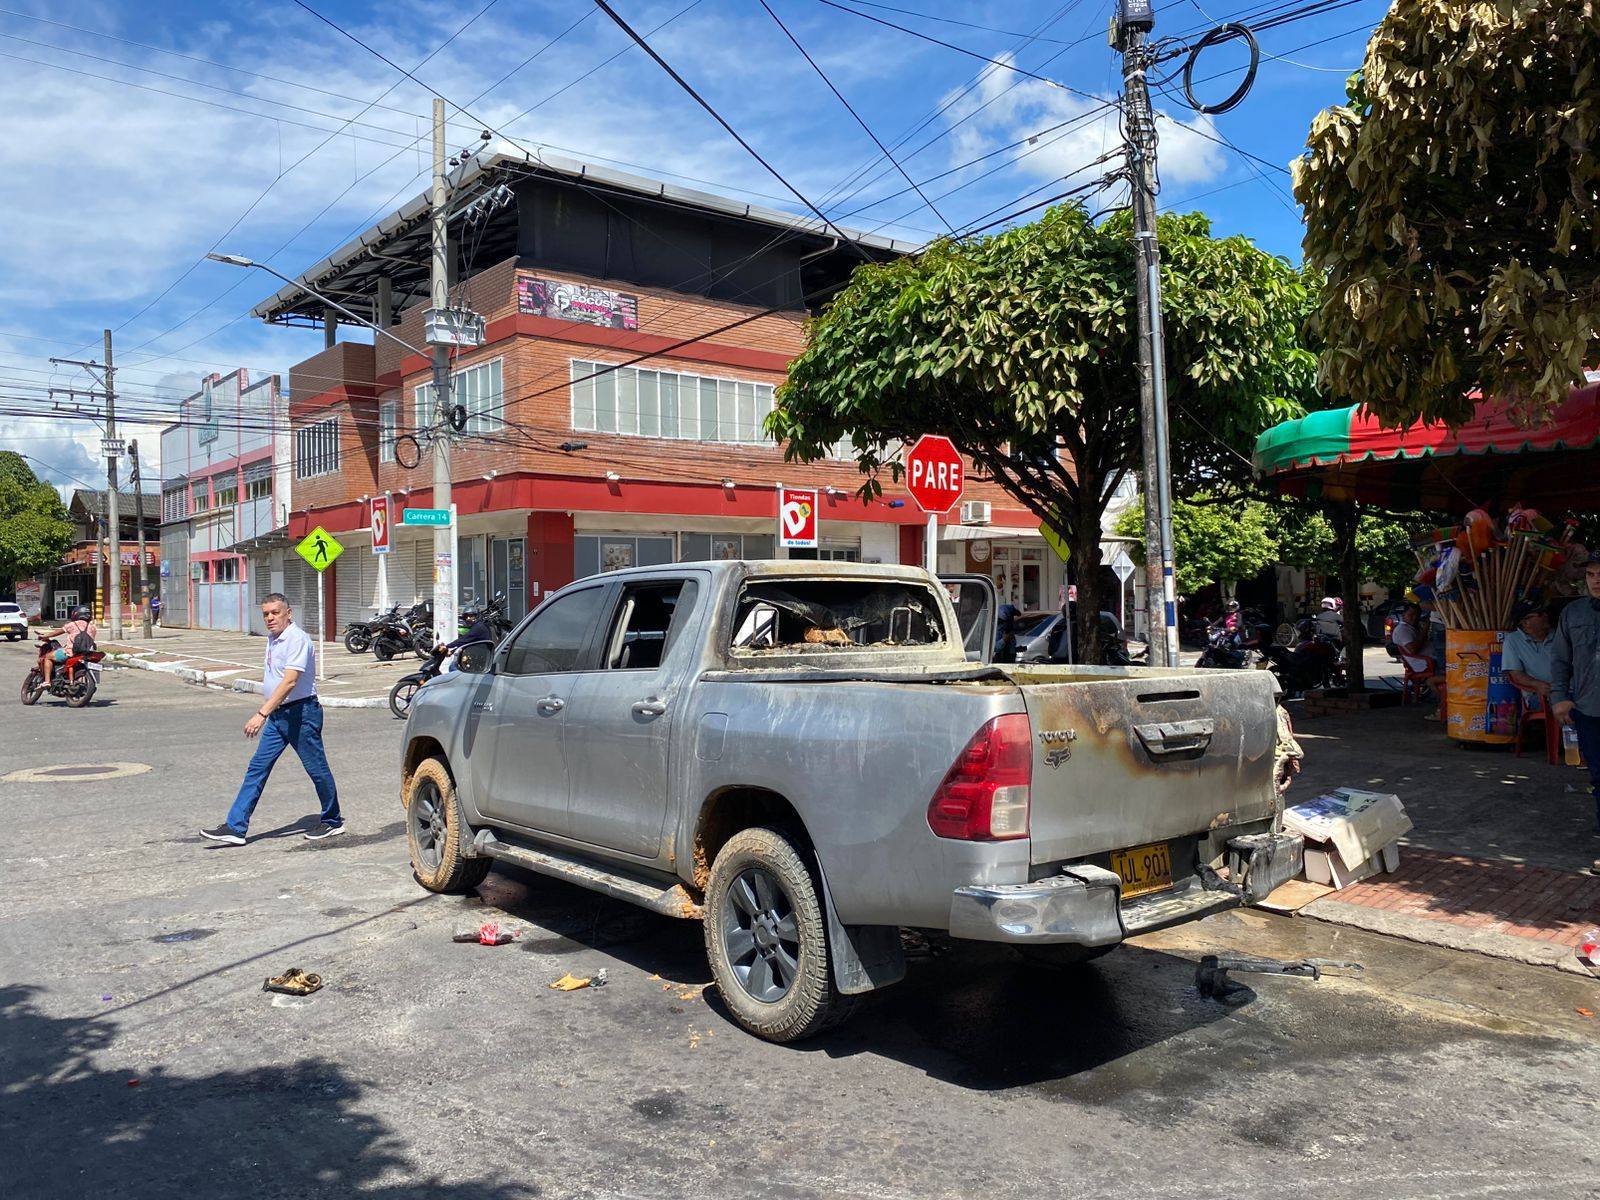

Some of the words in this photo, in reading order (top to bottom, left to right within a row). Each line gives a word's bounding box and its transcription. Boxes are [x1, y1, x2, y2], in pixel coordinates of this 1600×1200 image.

[571, 294, 611, 308] FOCUS
[912, 458, 960, 491] PARE
[406, 512, 436, 521] Carrera
[437, 512, 448, 521] 14
[1143, 851, 1170, 880] 901
